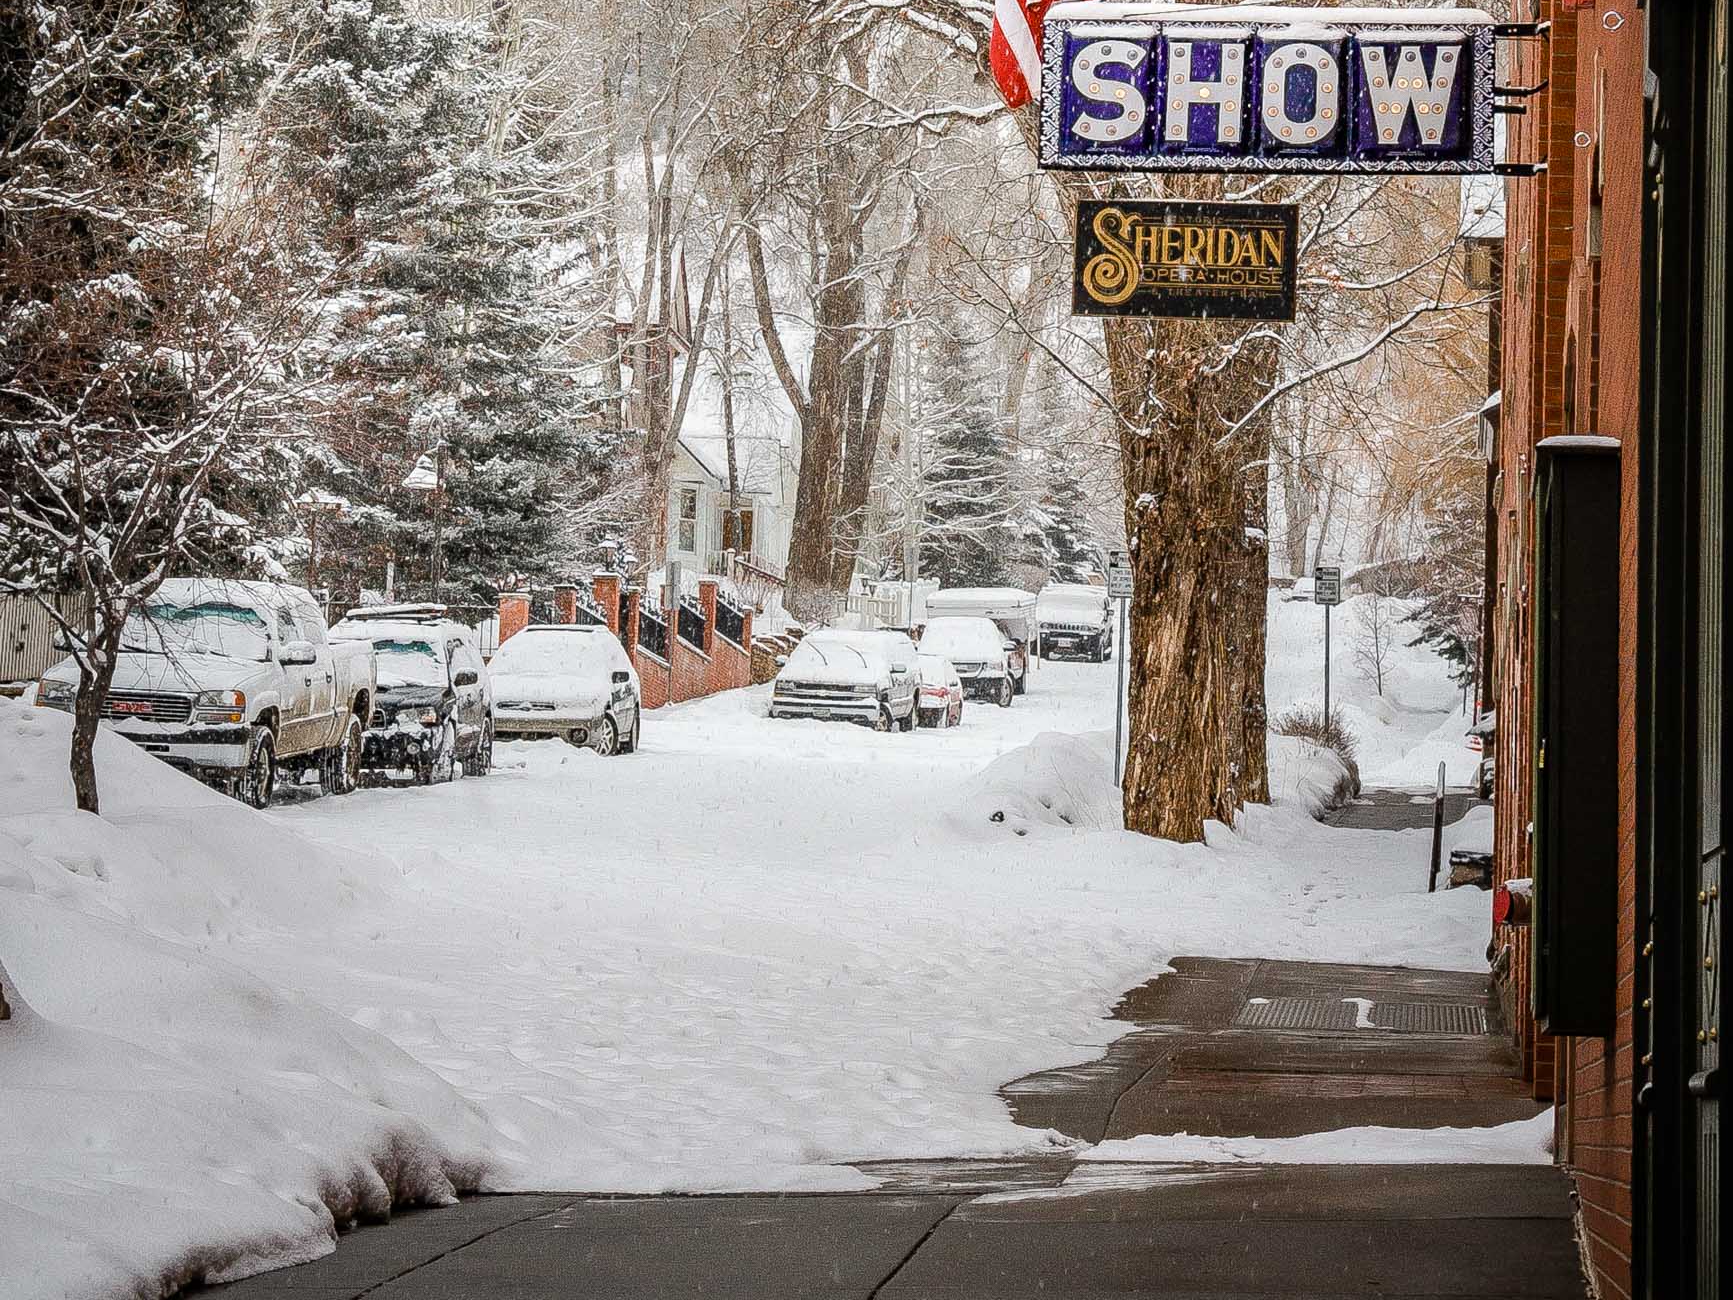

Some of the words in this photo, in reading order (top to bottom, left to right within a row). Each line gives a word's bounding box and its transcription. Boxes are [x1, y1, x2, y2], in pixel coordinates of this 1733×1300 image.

[1071, 39, 1463, 145] SHOW
[1083, 207, 1286, 306] SHERIDAN
[1142, 267, 1208, 283] OPERA
[1217, 269, 1283, 285] HOUSE
